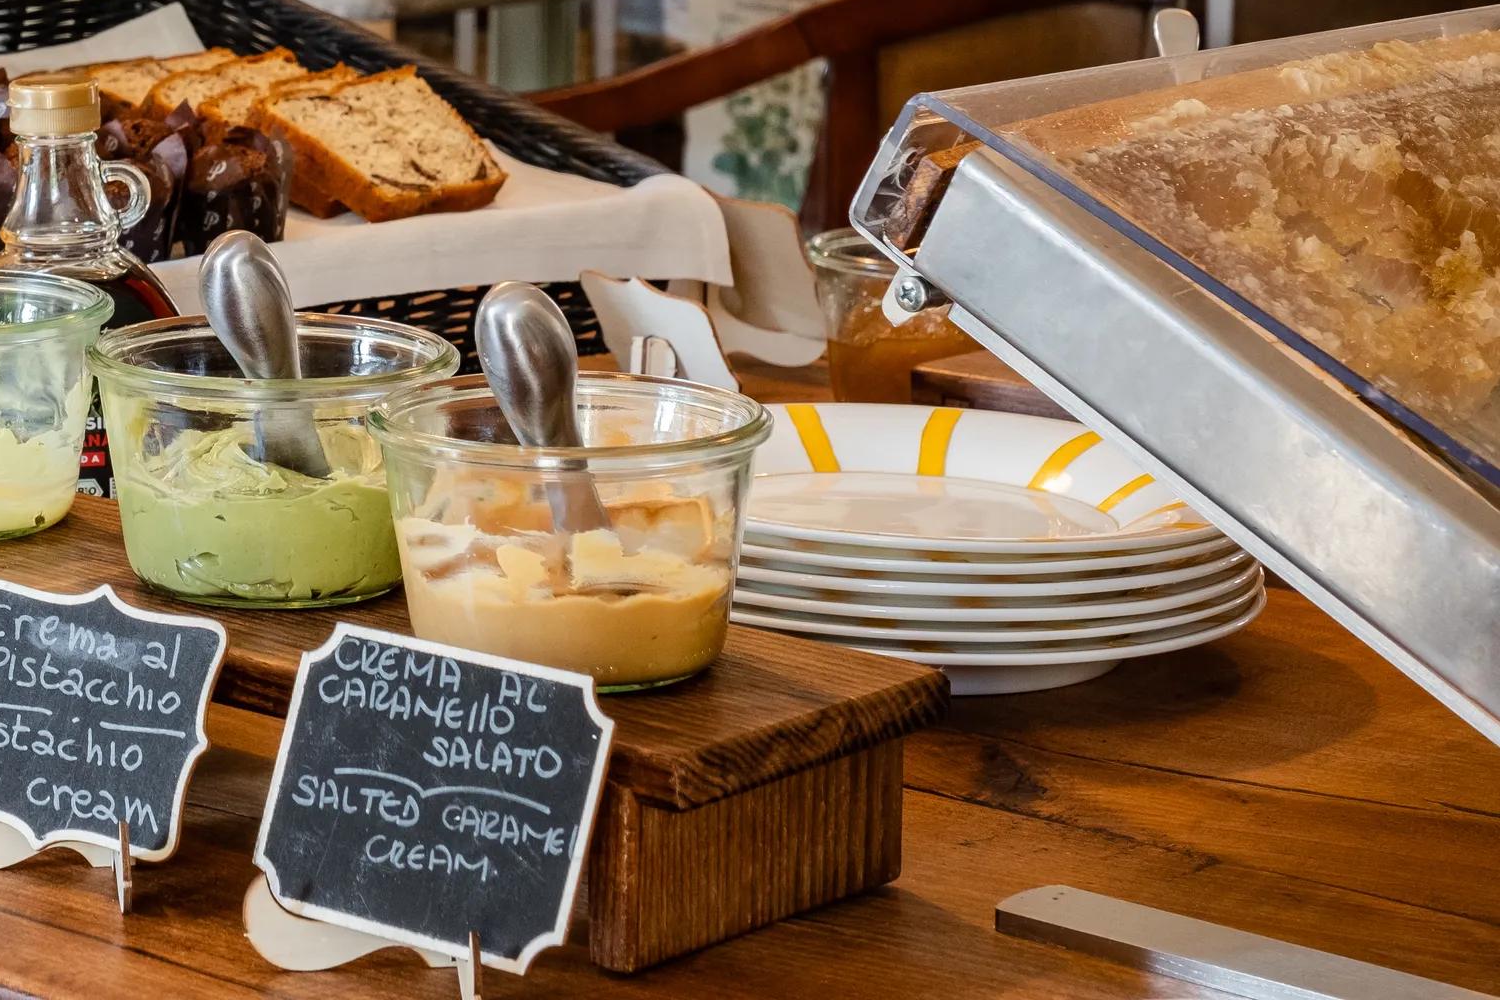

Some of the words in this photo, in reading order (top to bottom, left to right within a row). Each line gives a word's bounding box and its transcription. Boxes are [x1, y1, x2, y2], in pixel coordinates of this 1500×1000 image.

[141, 633, 182, 679] al
[334, 638, 461, 692] CREMA
[498, 671, 547, 713] AL
[423, 737, 562, 779] SALATO
[292, 775, 420, 827] SALTED
